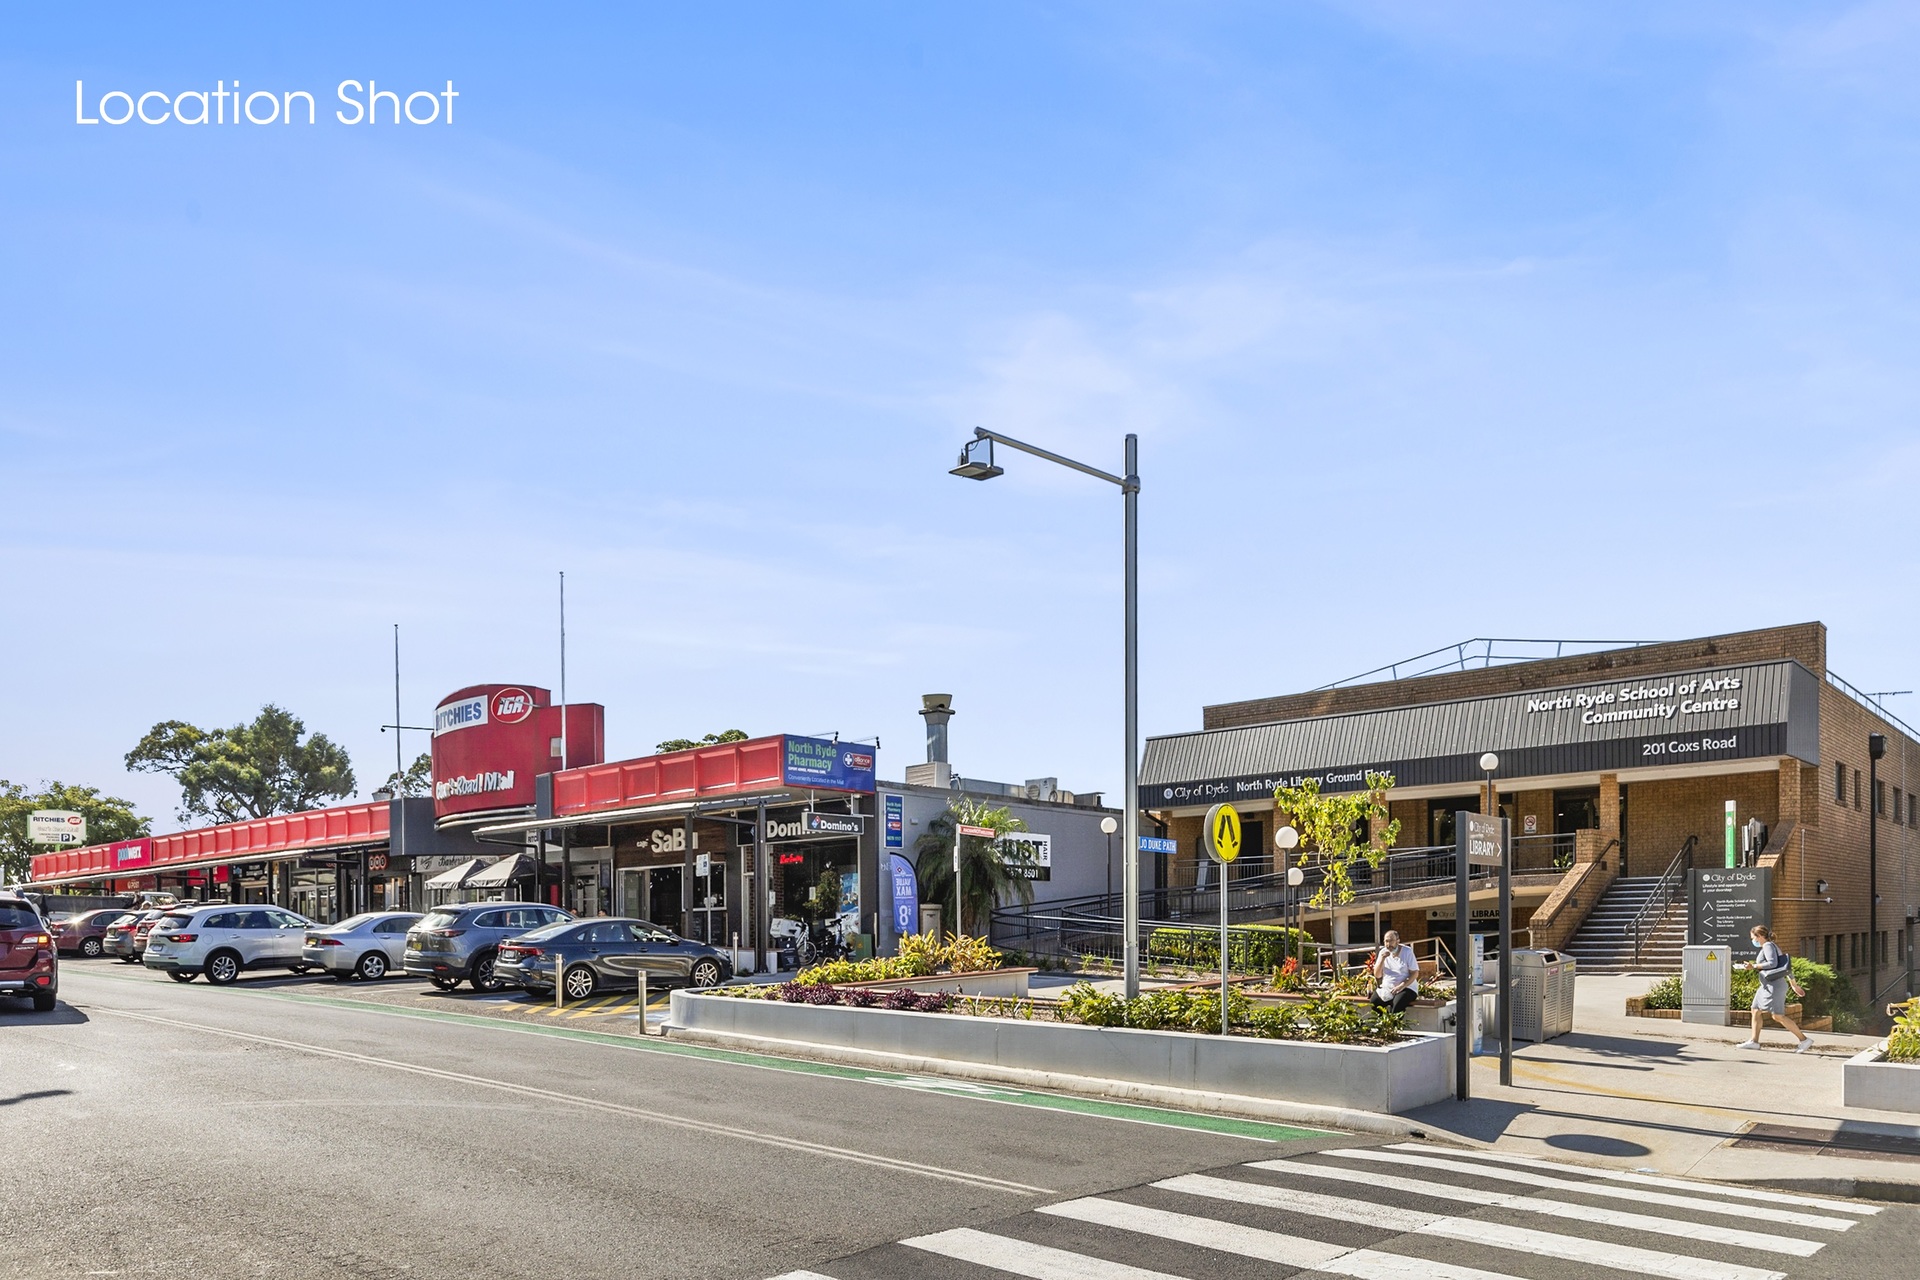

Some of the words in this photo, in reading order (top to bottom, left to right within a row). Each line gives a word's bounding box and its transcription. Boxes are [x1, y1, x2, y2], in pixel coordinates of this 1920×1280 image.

[1527, 696, 1572, 713] North
[1575, 691, 1615, 709] Ryde
[1619, 683, 1674, 701] School
[1678, 680, 1699, 695] of
[1700, 677, 1741, 693] Arts
[436, 702, 482, 731] RITCHIES
[1582, 702, 1676, 725] Community
[1681, 698, 1739, 714] Centre
[788, 740, 813, 755] North
[816, 744, 837, 758] Ryde
[1642, 742, 1666, 755] 201
[1669, 741, 1699, 753] Coxs
[1702, 737, 1737, 750] Road
[788, 754, 832, 771] Pharmacy
[1174, 787, 1191, 800] City
[1193, 784, 1204, 797] of
[1205, 783, 1229, 798] Ryde
[1236, 780, 1262, 791] North
[1265, 778, 1288, 791] Ryde
[1326, 770, 1361, 783] Ground
[820, 820, 859, 832] Domino's
[1148, 840, 1162, 850] DUKE
[1163, 841, 1176, 851] PATH
[1470, 840, 1495, 856] LIBRARY
[1711, 874, 1725, 883] City
[1727, 873, 1736, 881] of
[1736, 872, 1756, 882] Ryde
[1472, 910, 1500, 918] LIBRAR
